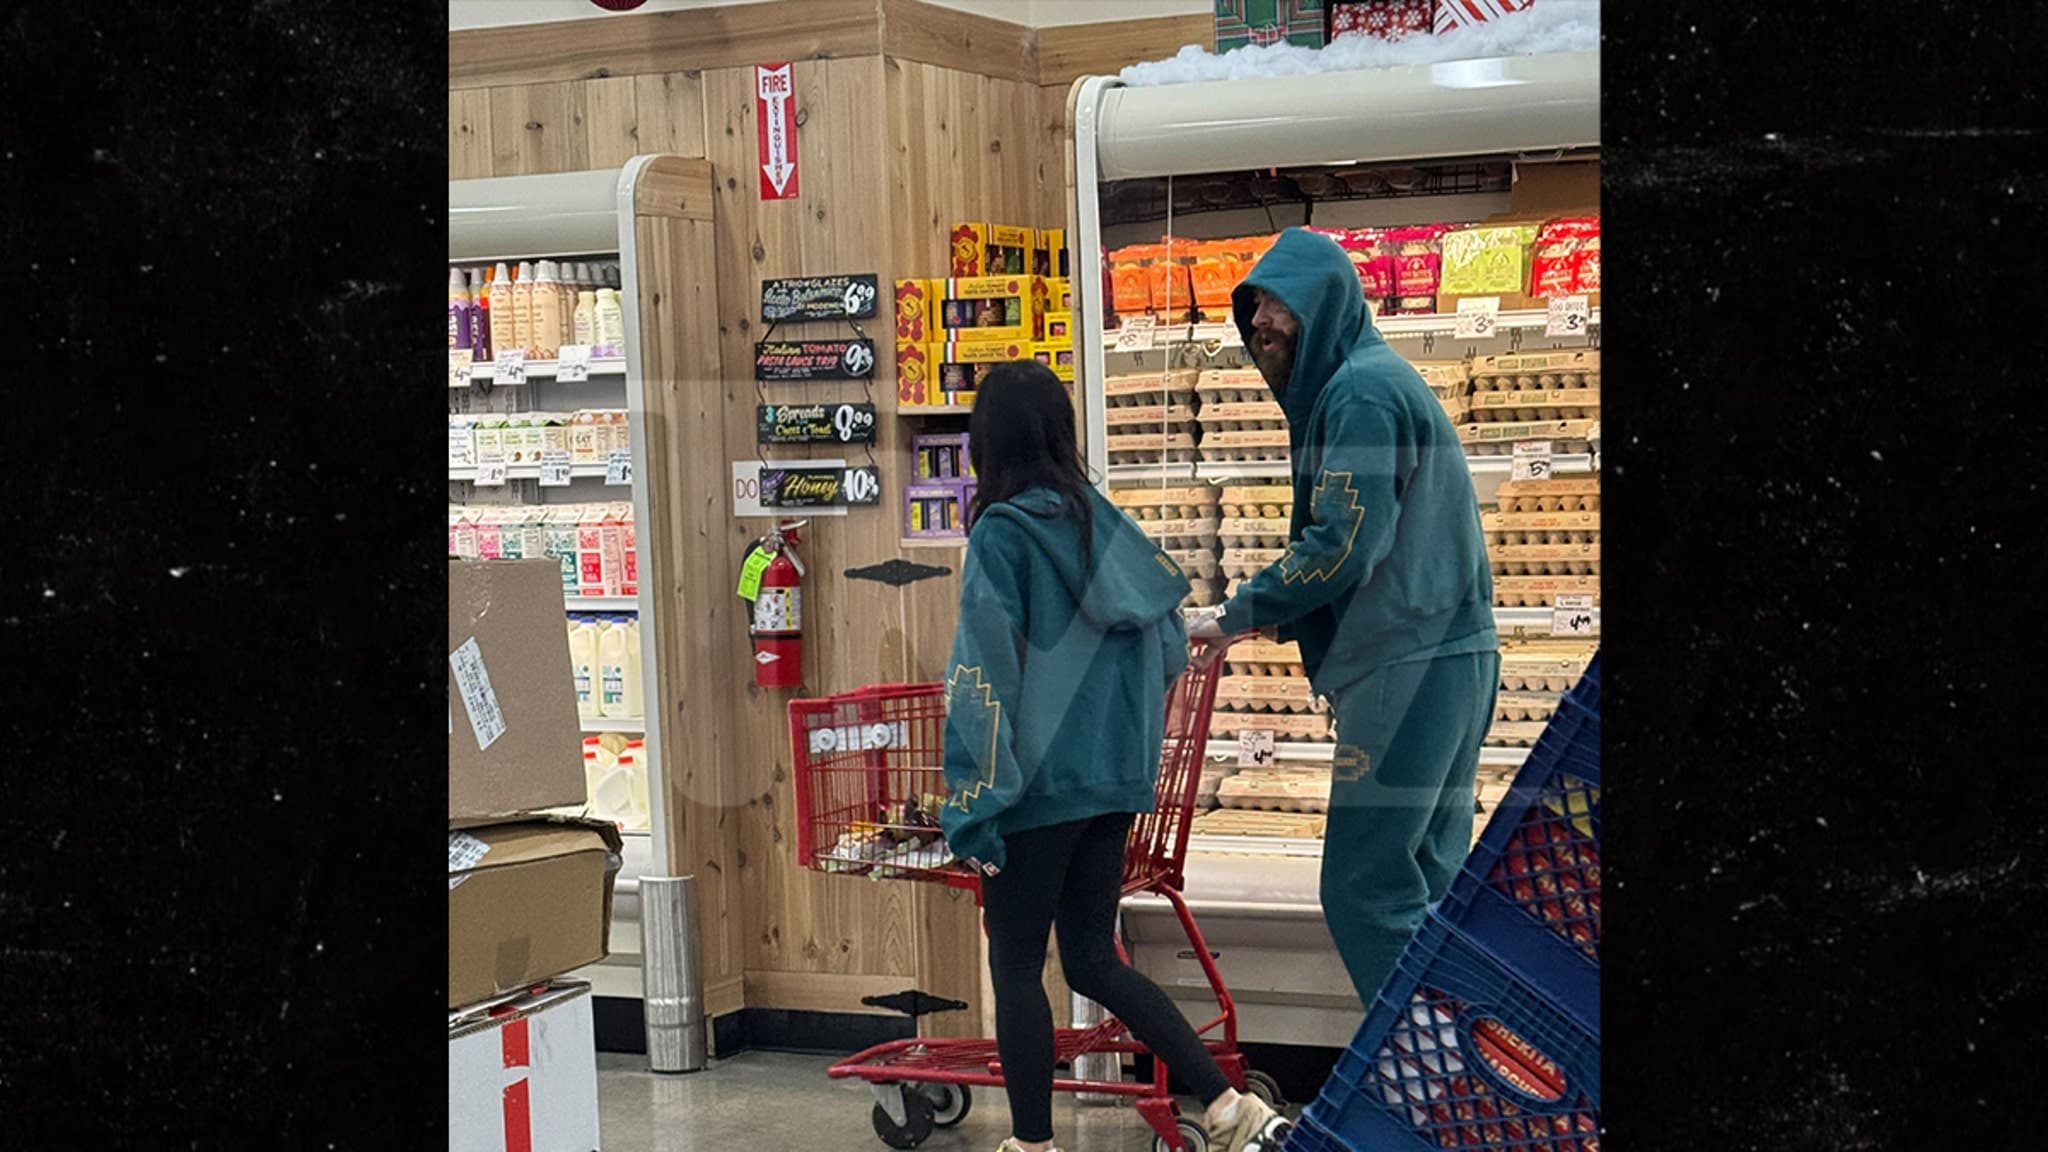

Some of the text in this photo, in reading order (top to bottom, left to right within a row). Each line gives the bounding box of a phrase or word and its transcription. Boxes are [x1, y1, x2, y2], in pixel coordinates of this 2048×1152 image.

[762, 74, 787, 93] FIRE
[772, 96, 783, 185] EXTINGUISHER
[810, 277, 849, 288] GLAZES
[763, 344, 848, 355] Italian TOMATO
[757, 355, 839, 366] PASTA SAUCE TRIO
[776, 404, 825, 424] Spreads
[736, 478, 758, 499] DO
[783, 473, 839, 502] Honey
